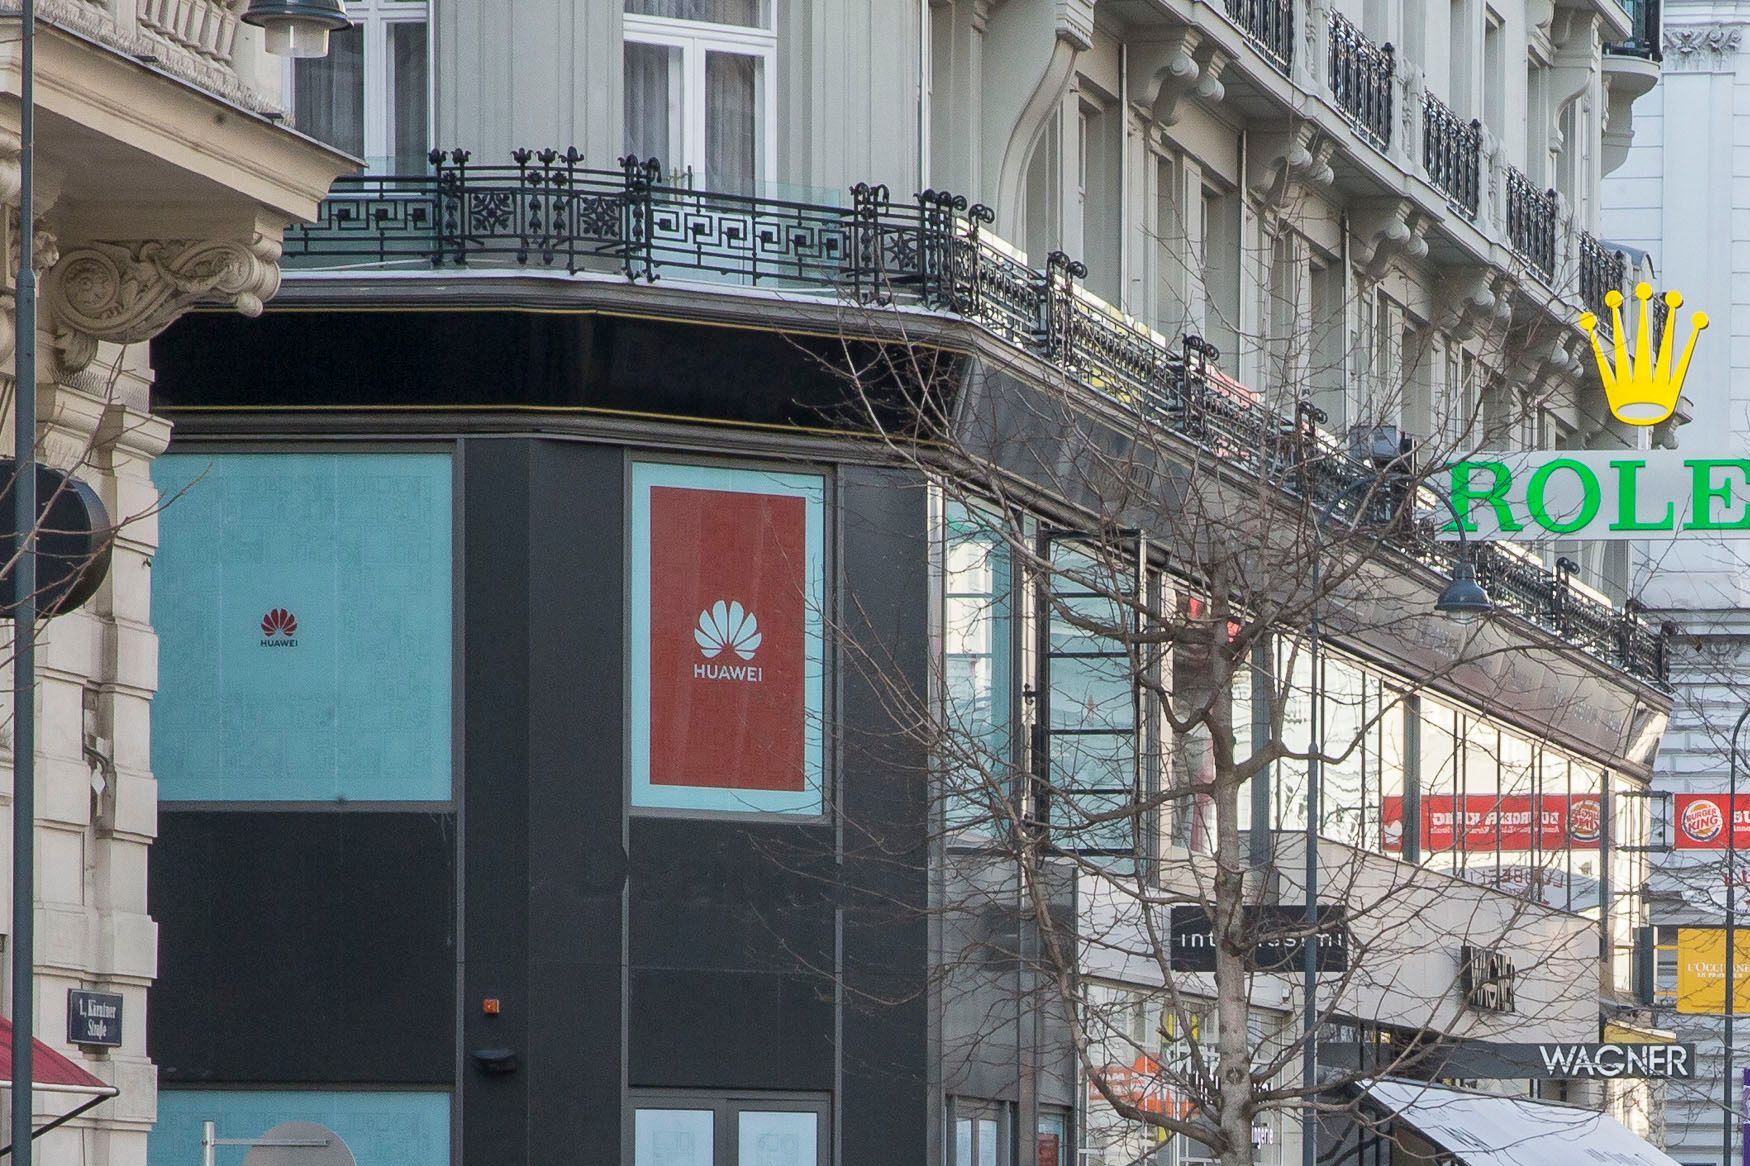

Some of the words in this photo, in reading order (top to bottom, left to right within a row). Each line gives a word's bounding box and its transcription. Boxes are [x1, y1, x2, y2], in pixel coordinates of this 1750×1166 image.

[694, 664, 762, 682] HUAWEI
[87, 1018, 107, 1040] Straße
[1538, 1045, 1688, 1077] WAGNER
